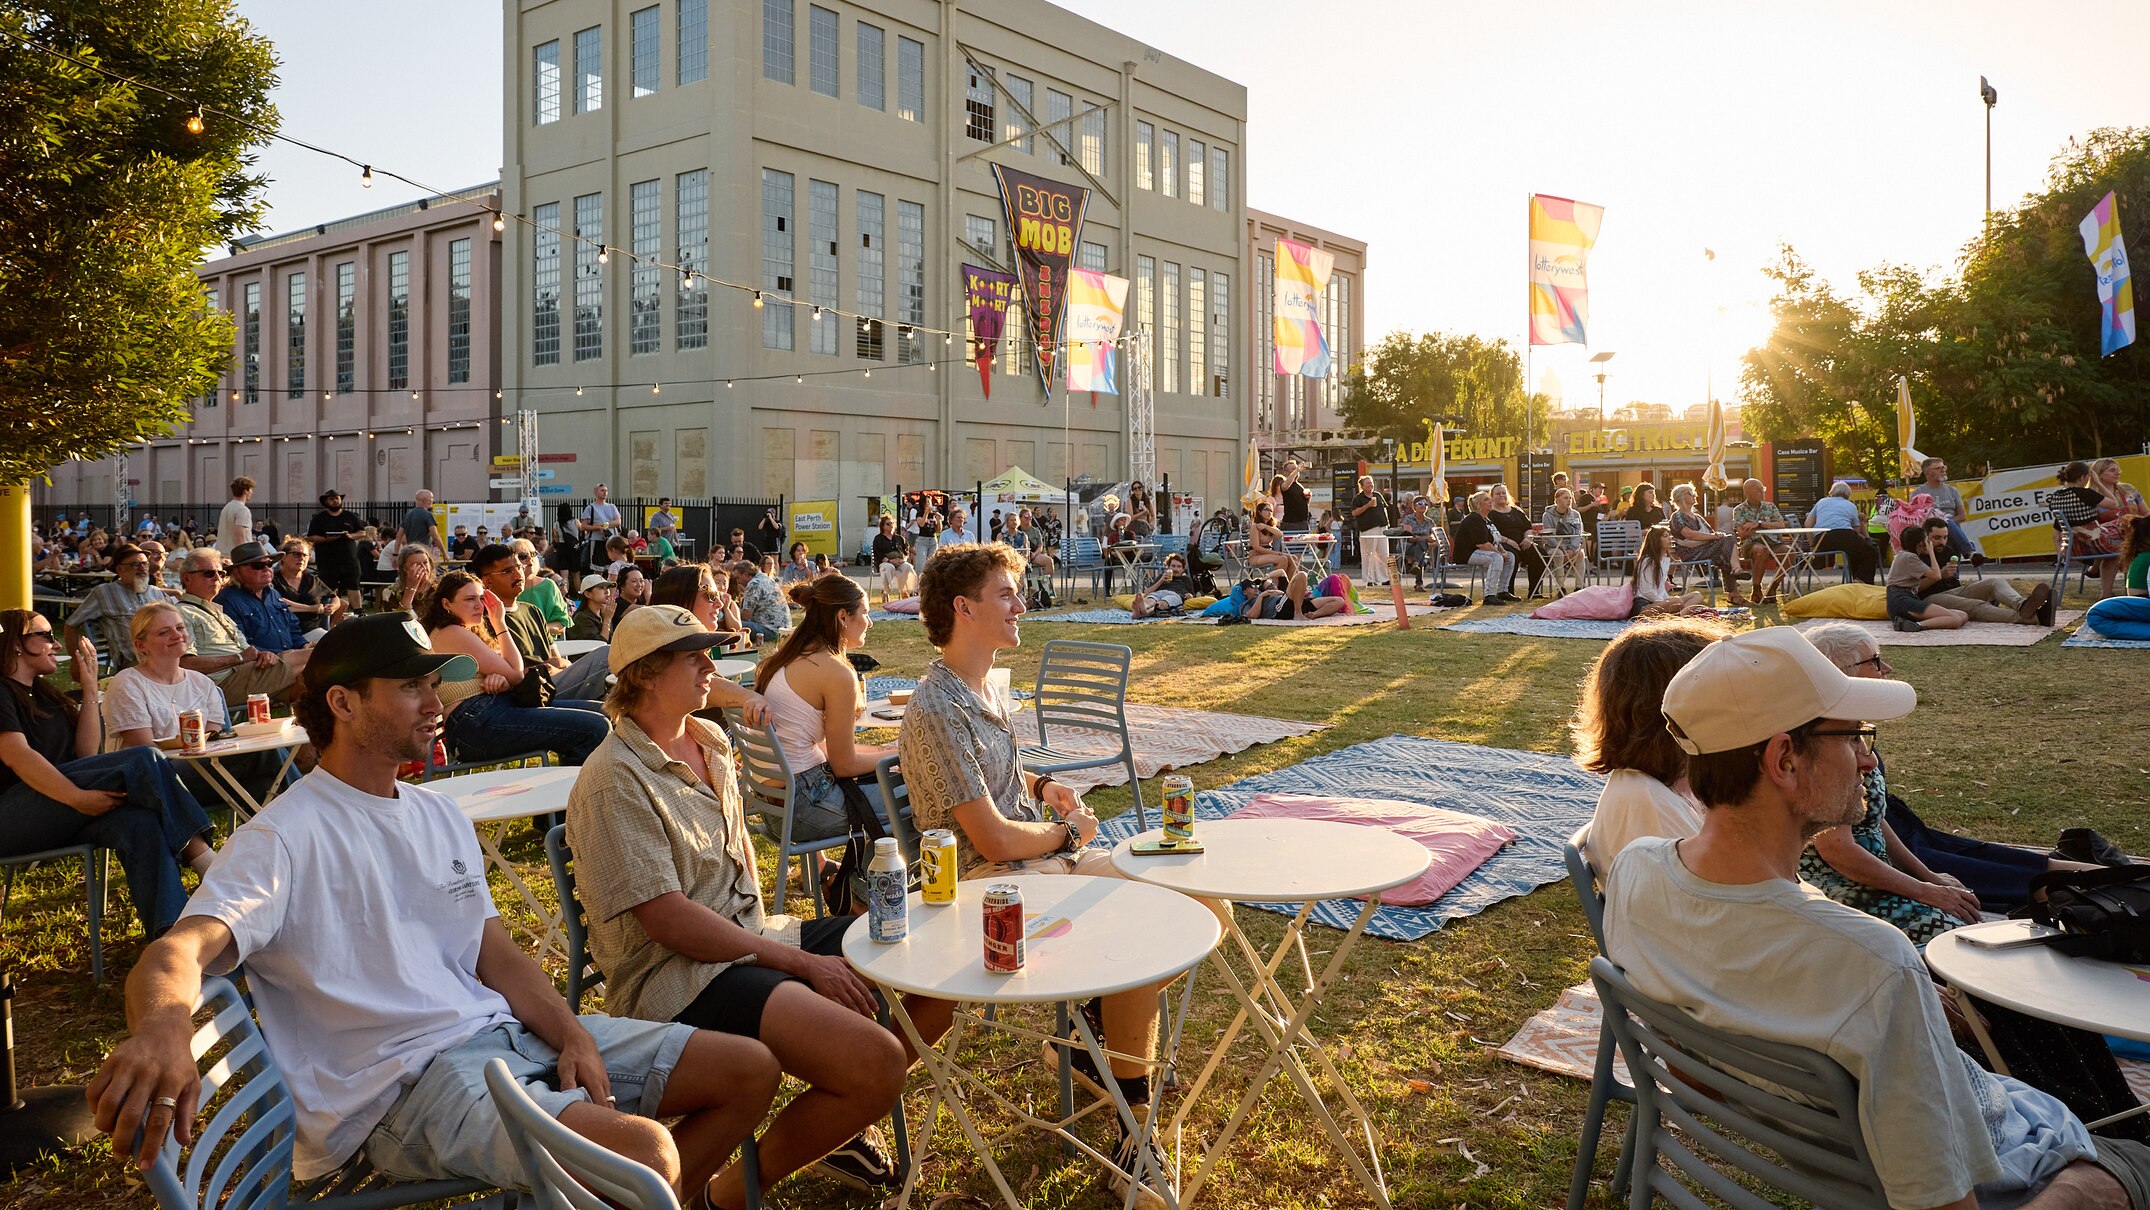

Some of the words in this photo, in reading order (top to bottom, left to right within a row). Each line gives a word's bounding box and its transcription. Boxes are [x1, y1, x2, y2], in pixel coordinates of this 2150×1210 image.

[1018, 185, 1071, 222] BIG
[1019, 217, 1072, 255] MOB
[1534, 253, 1583, 277] lotterywest
[1395, 443, 1408, 462] A
[1569, 424, 1731, 454] ELECTRICIT
[1975, 496, 2029, 512] Dance.
[2034, 491, 2054, 505] Ea
[806, 514, 822, 522] Perth
[812, 522, 831, 530] Station
[1988, 510, 2054, 530] Conven
